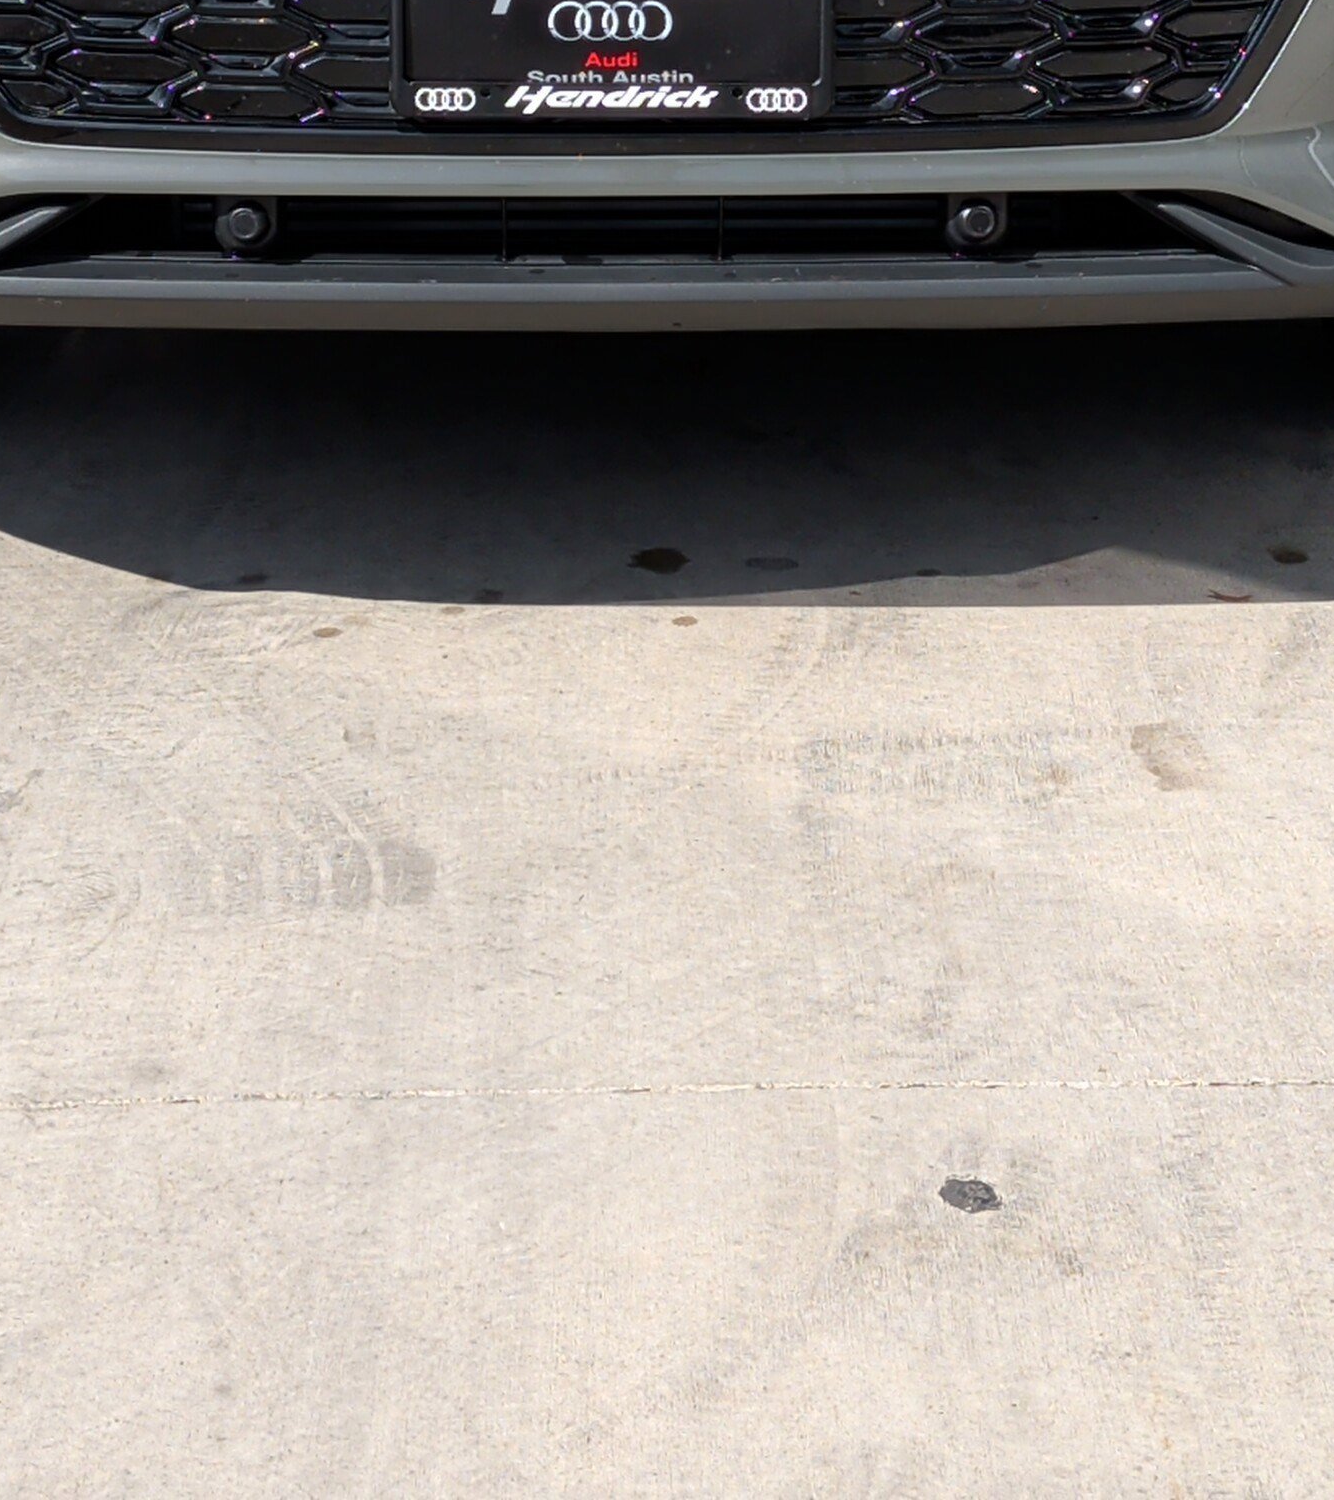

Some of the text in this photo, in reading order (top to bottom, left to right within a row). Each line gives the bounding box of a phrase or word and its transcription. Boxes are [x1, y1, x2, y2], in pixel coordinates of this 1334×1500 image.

[584, 51, 639, 68] Audi
[526, 70, 695, 84] South Austin
[504, 85, 720, 115] Hendrick
